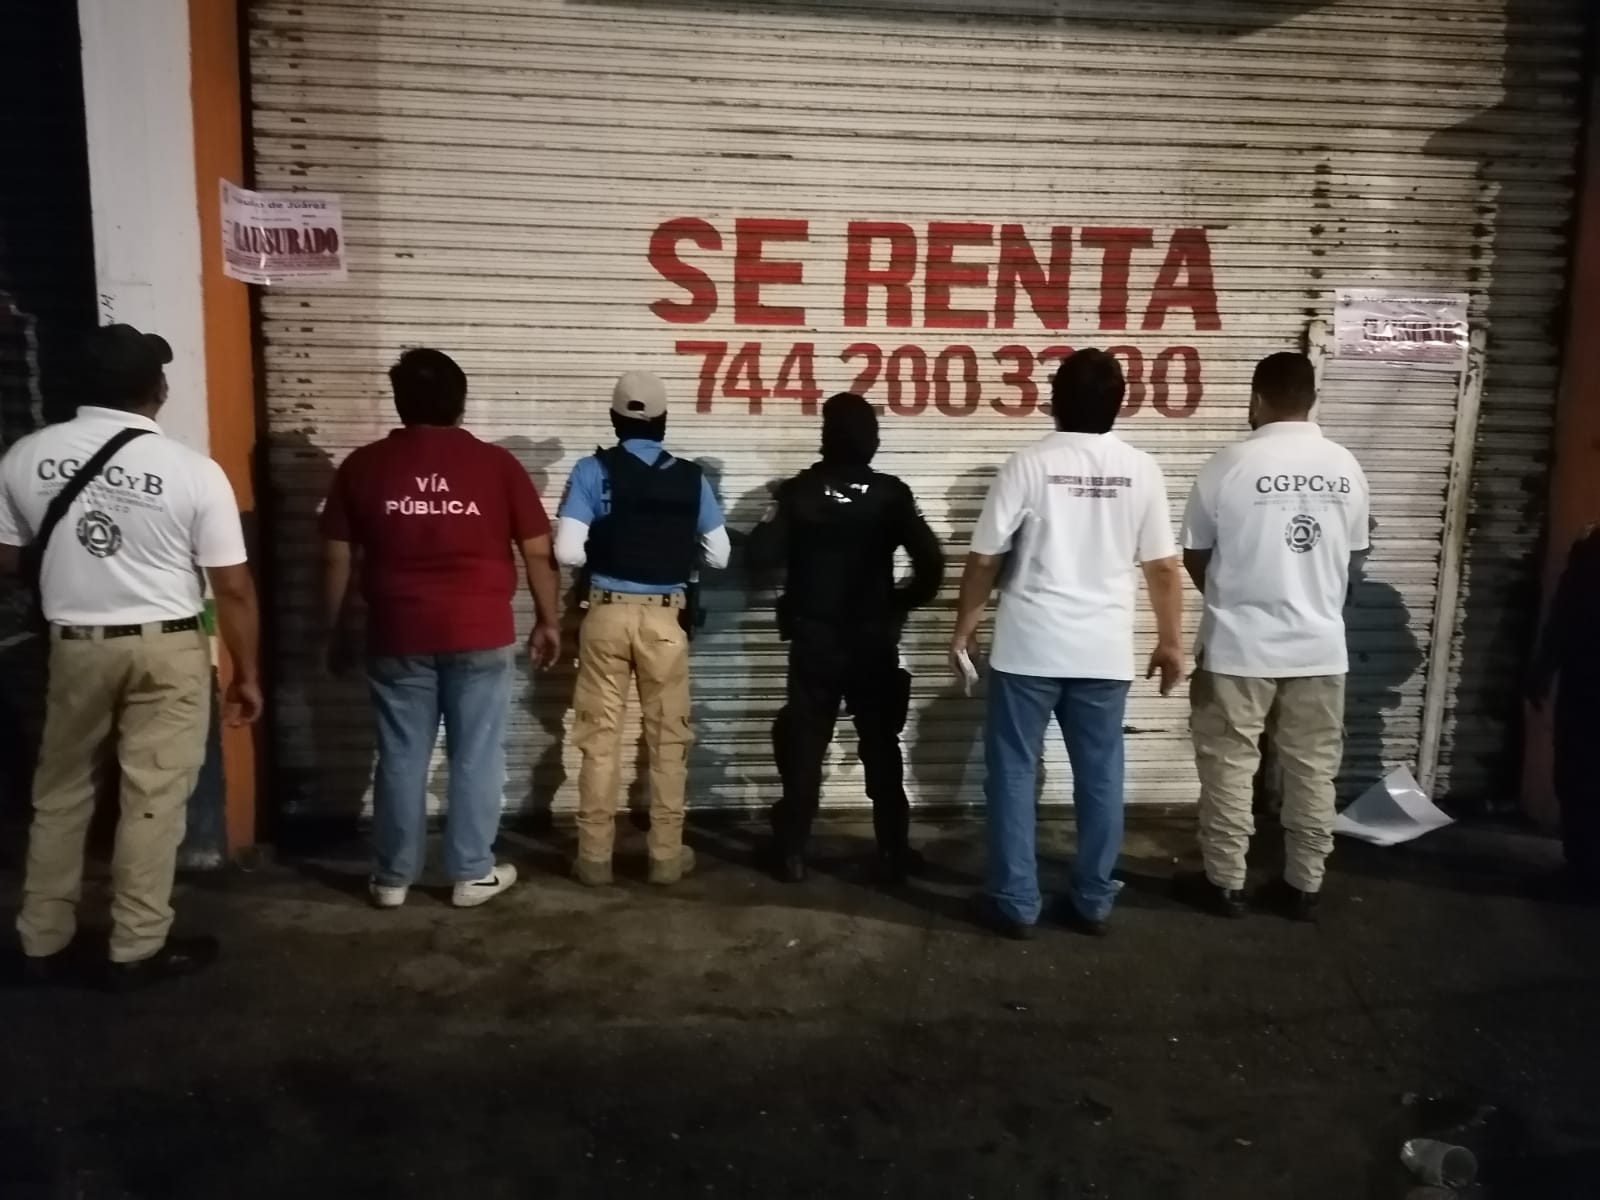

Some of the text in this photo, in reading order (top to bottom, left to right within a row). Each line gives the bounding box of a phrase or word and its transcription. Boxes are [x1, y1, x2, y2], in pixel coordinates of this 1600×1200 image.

[647, 217, 1222, 331] SE RENTA
[675, 340, 823, 416] 744
[385, 496, 481, 515] PÚBLICA
[415, 473, 450, 492] VÍA
